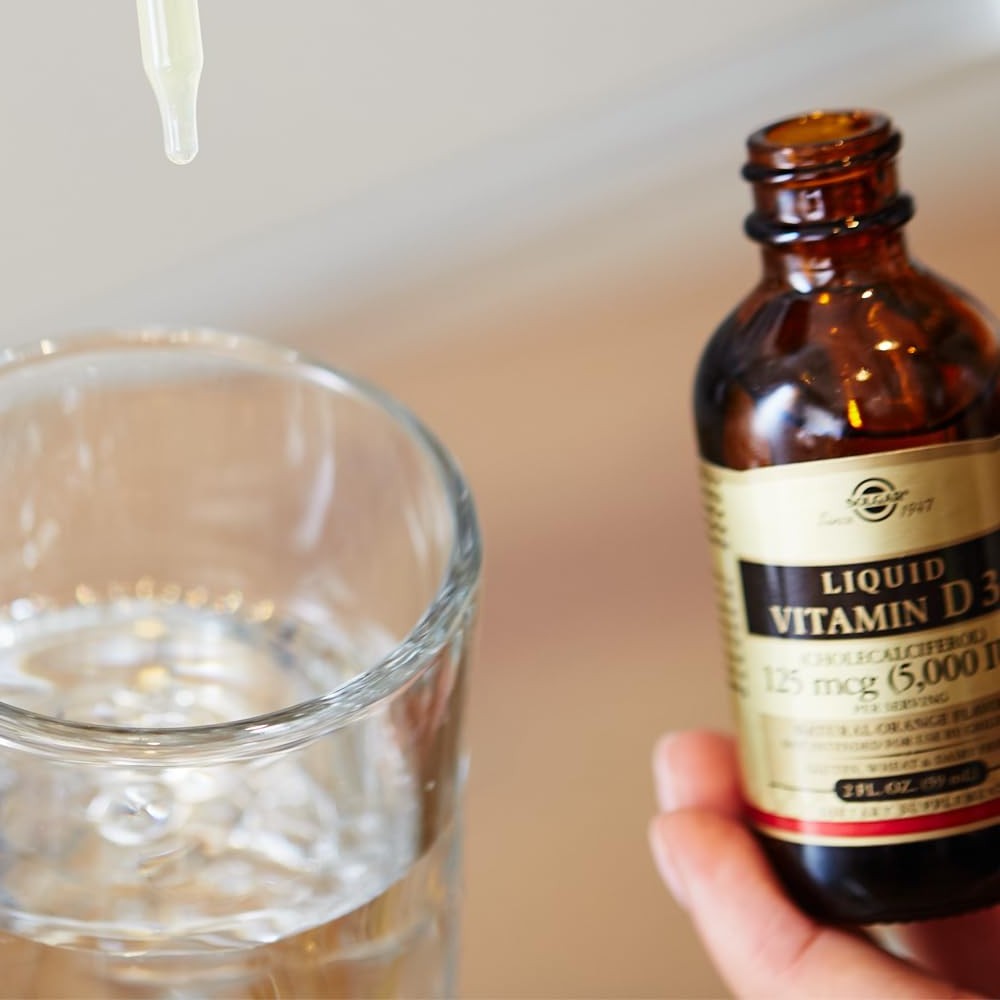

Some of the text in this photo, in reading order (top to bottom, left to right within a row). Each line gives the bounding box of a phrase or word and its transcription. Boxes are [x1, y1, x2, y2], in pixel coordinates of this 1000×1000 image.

[820, 557, 945, 595] LIQUID
[769, 596, 929, 636] VITAMIN
[762, 665, 803, 695] 125
[813, 673, 881, 703] mcg
[887, 648, 979, 694] (5,000
